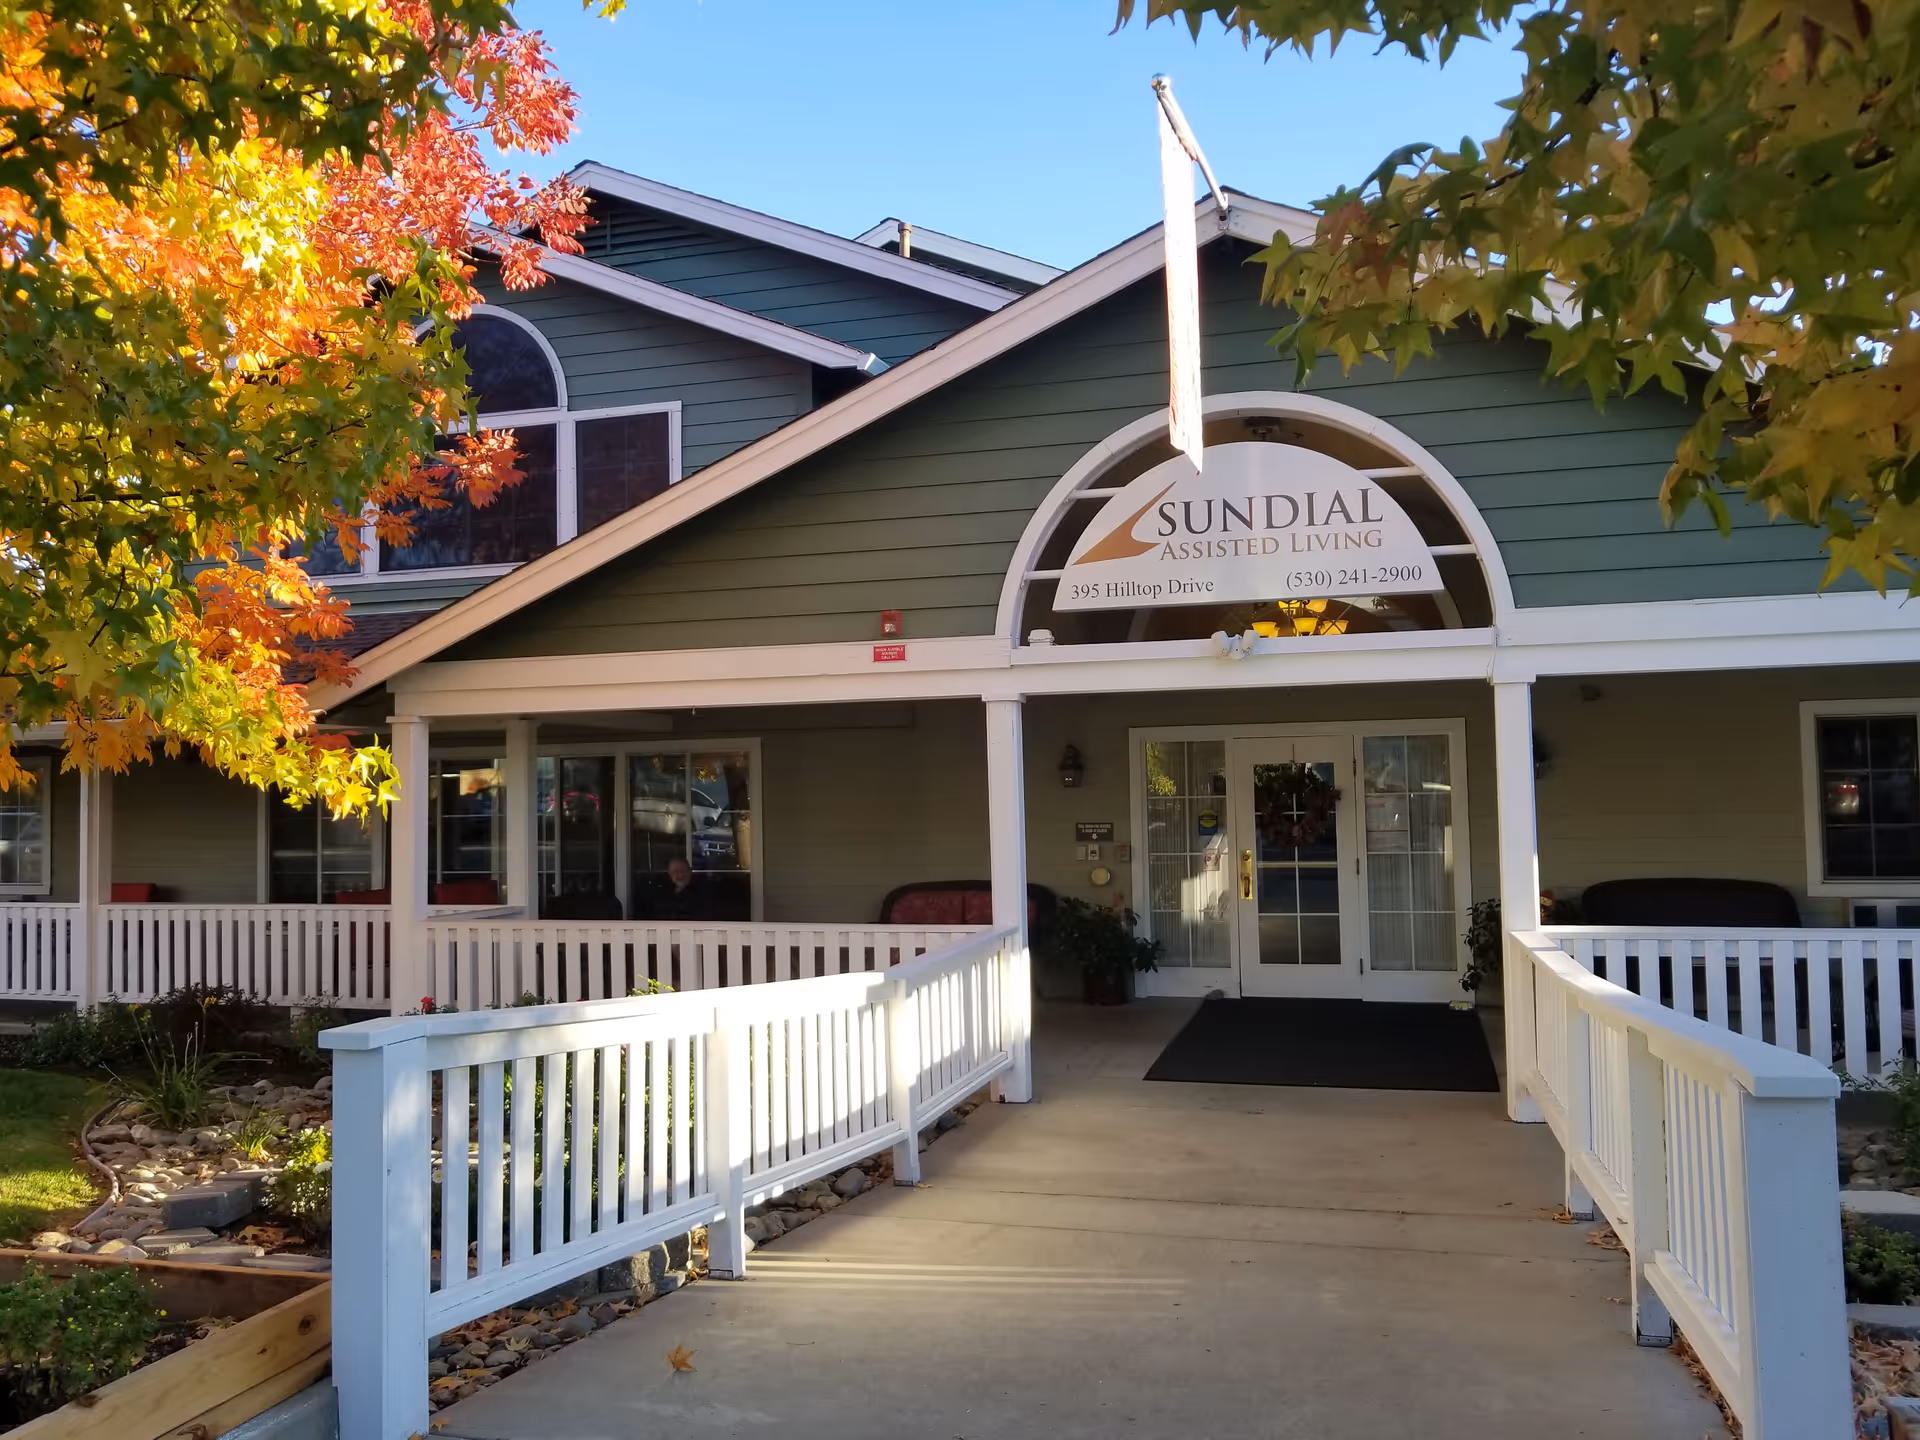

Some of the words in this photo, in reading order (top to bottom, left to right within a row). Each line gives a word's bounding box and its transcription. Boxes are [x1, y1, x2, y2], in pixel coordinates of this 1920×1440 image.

[1157, 487, 1384, 537] SUNDIAL
[1160, 536, 1280, 561] ASSISTED
[1291, 529, 1383, 554] LIVING
[1070, 584, 1100, 600] 395
[1106, 580, 1162, 600] Hilltop
[1168, 578, 1214, 595] Drive
[1286, 570, 1332, 591] (530)
[1338, 565, 1422, 586] 241-2900
